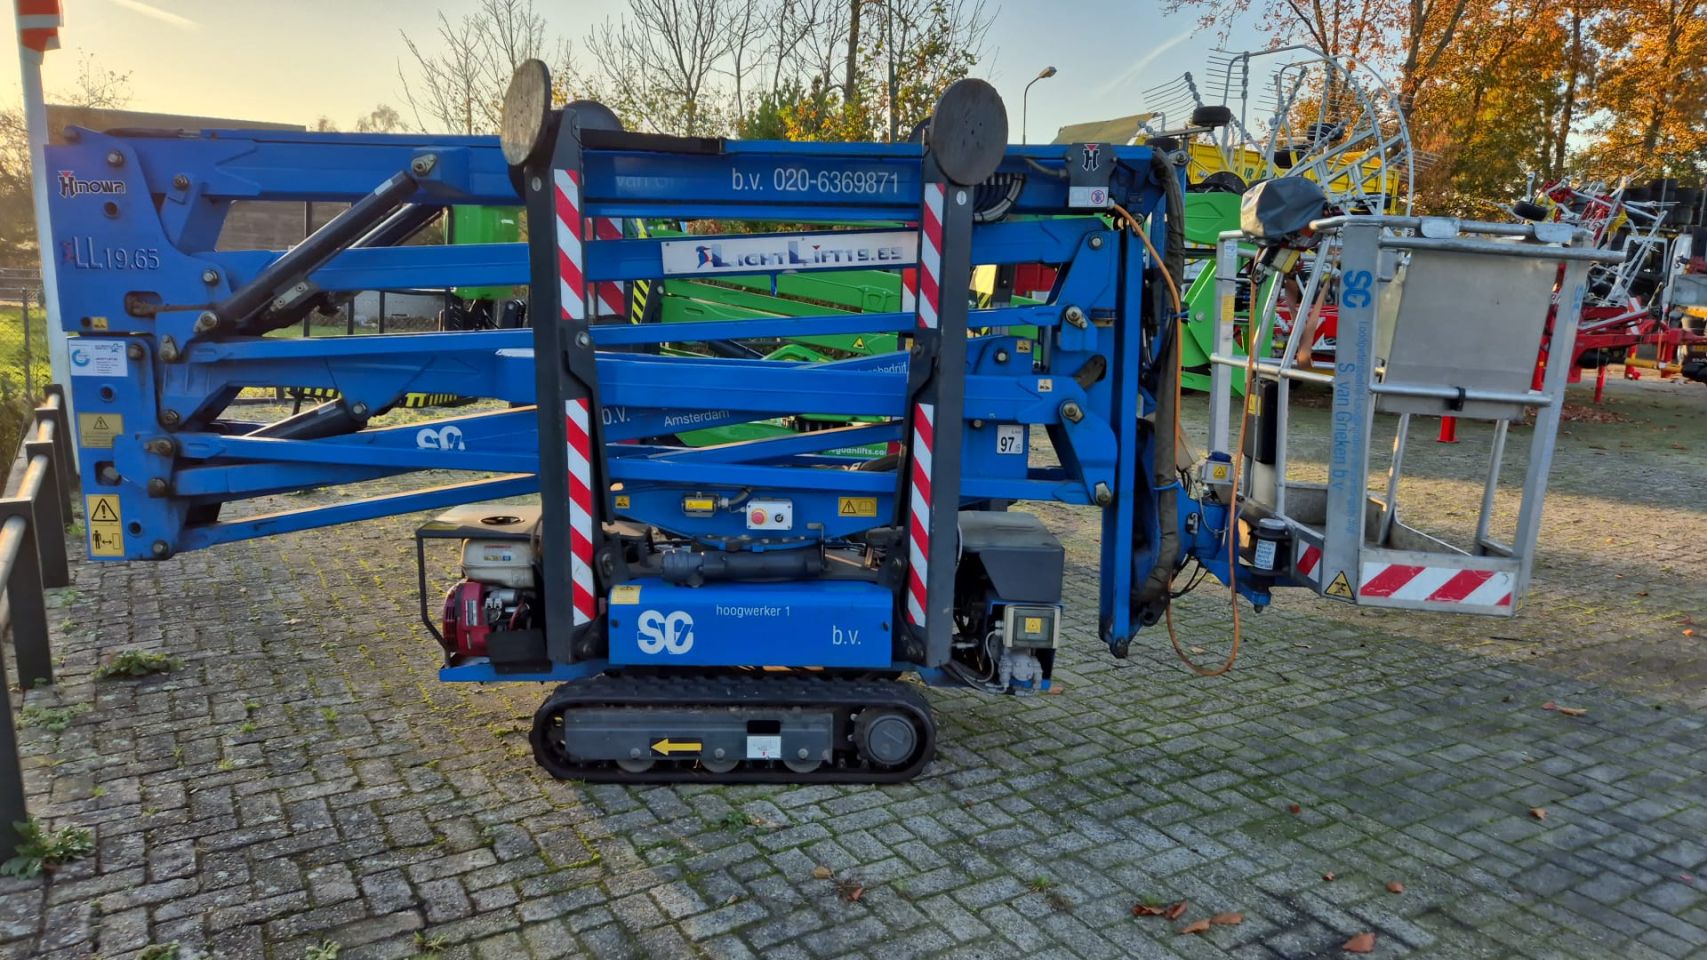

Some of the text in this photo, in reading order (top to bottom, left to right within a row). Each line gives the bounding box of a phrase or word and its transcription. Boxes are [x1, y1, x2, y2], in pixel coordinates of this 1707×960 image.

[732, 168, 763, 191] b.v.
[773, 168, 899, 193] 020-6369871
[1336, 381, 1351, 407] van
[664, 409, 731, 428] Amsterdam
[1000, 436, 1015, 452] 97
[1333, 410, 1353, 465] Grieken
[716, 604, 790, 619] hoogwerker 1
[832, 624, 862, 646] b.v.
